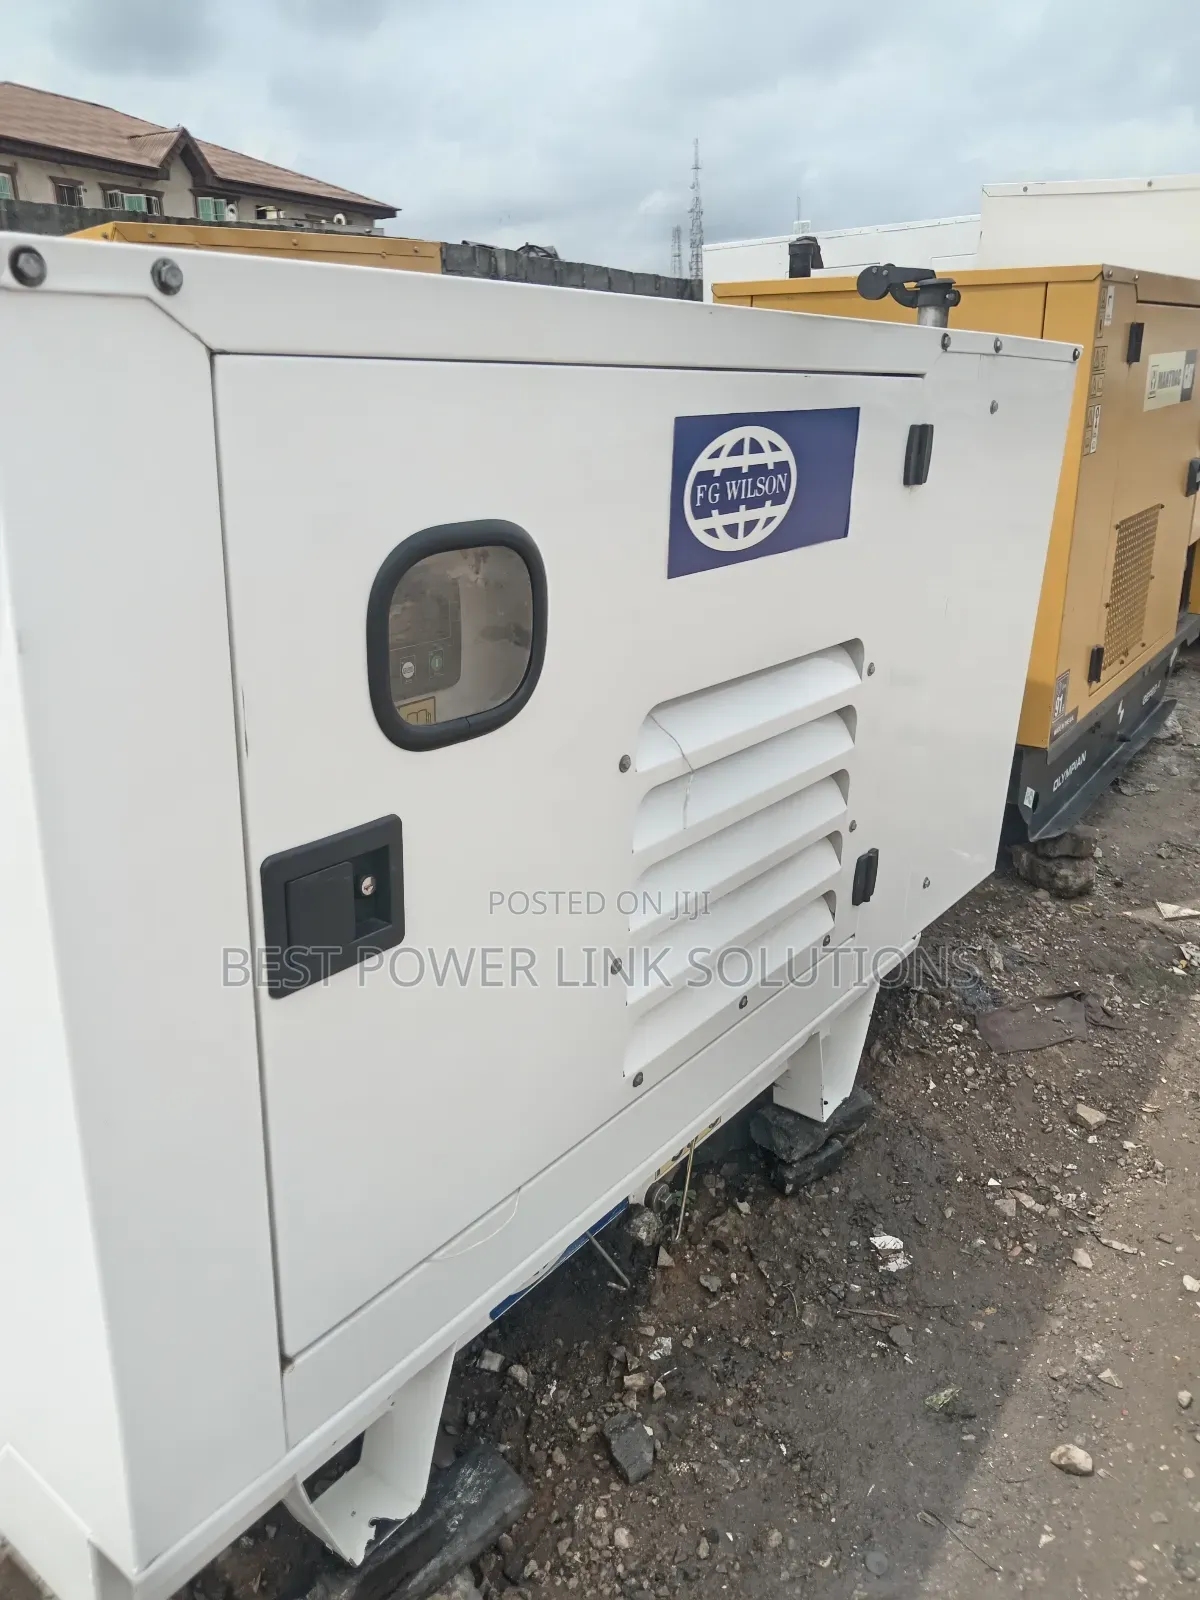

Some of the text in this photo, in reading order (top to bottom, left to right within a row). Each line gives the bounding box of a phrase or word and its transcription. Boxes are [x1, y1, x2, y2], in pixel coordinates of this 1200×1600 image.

[695, 472, 788, 506] FG WILSON
[1053, 750, 1087, 792] OLYMPIAN
